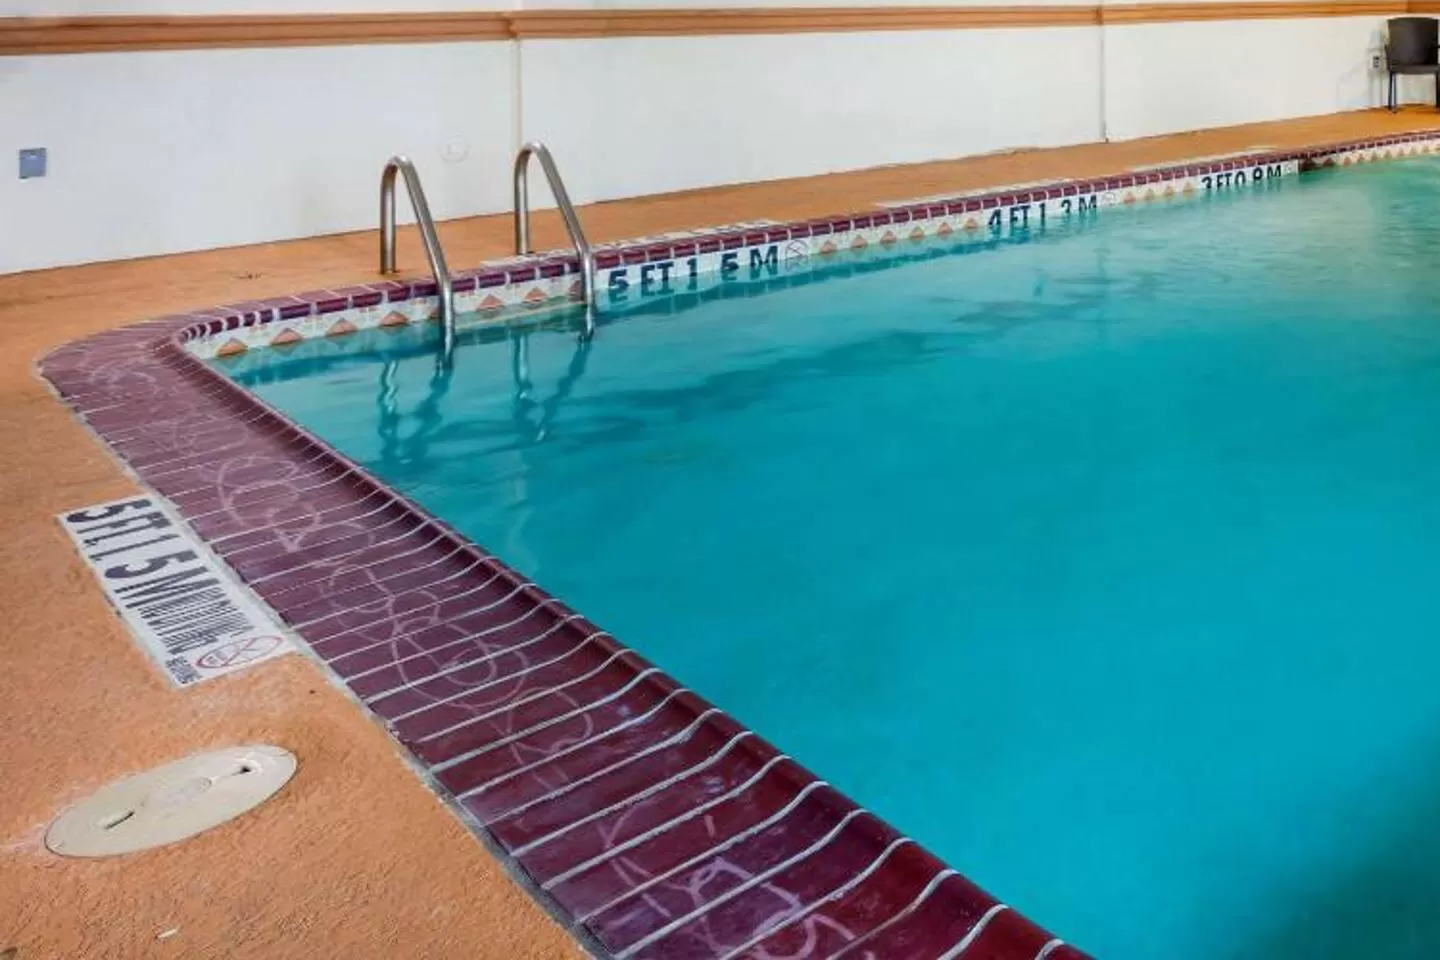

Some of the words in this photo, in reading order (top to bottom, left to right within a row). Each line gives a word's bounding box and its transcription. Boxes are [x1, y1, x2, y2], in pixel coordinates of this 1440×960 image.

[1009, 204, 1030, 225] FT
[1078, 194, 1098, 211] M
[608, 270, 630, 291] 5
[641, 260, 675, 283] FT
[750, 244, 779, 267] M
[66, 498, 153, 523] 5
[113, 564, 221, 609] M
